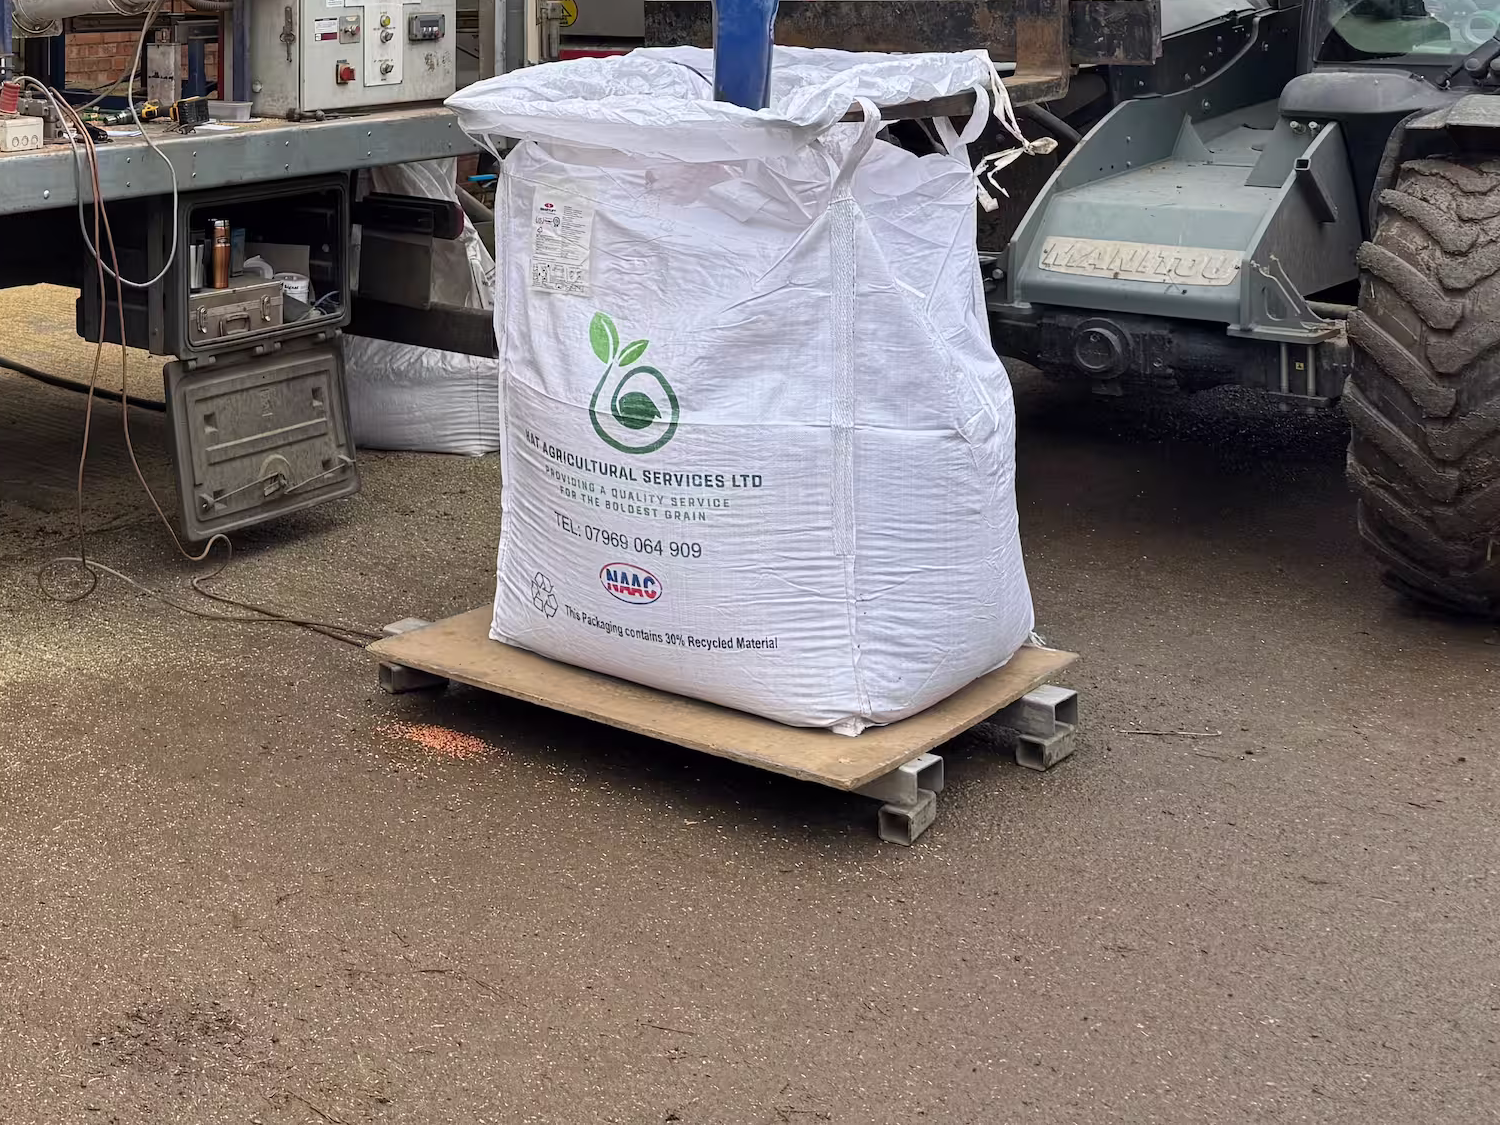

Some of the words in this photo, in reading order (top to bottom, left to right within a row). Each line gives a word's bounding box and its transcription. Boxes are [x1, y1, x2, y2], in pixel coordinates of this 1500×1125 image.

[1042, 242, 1228, 279] MANITOU
[542, 444, 637, 482] AGRICULTURAL
[642, 469, 725, 488] SERVICES
[732, 474, 762, 488] LTD
[545, 464, 595, 492] PROVIDING
[601, 486, 606, 495] A
[612, 488, 664, 505] QUALITY
[671, 497, 730, 508] SERVICE
[559, 485, 577, 501] FOR
[581, 493, 600, 507] THE
[605, 500, 658, 518] BOLDEST
[665, 510, 706, 521] GRAIN
[554, 511, 581, 537] TEL:
[585, 525, 628, 550] 07969
[634, 537, 663, 556] 064
[669, 541, 702, 558] 909
[606, 568, 657, 599] NAAC
[564, 604, 581, 621] This
[581, 612, 623, 638] Packaging
[625, 626, 663, 643] contains
[665, 632, 685, 647] 30%
[687, 635, 733, 652] Recycled
[736, 636, 778, 649] Material
